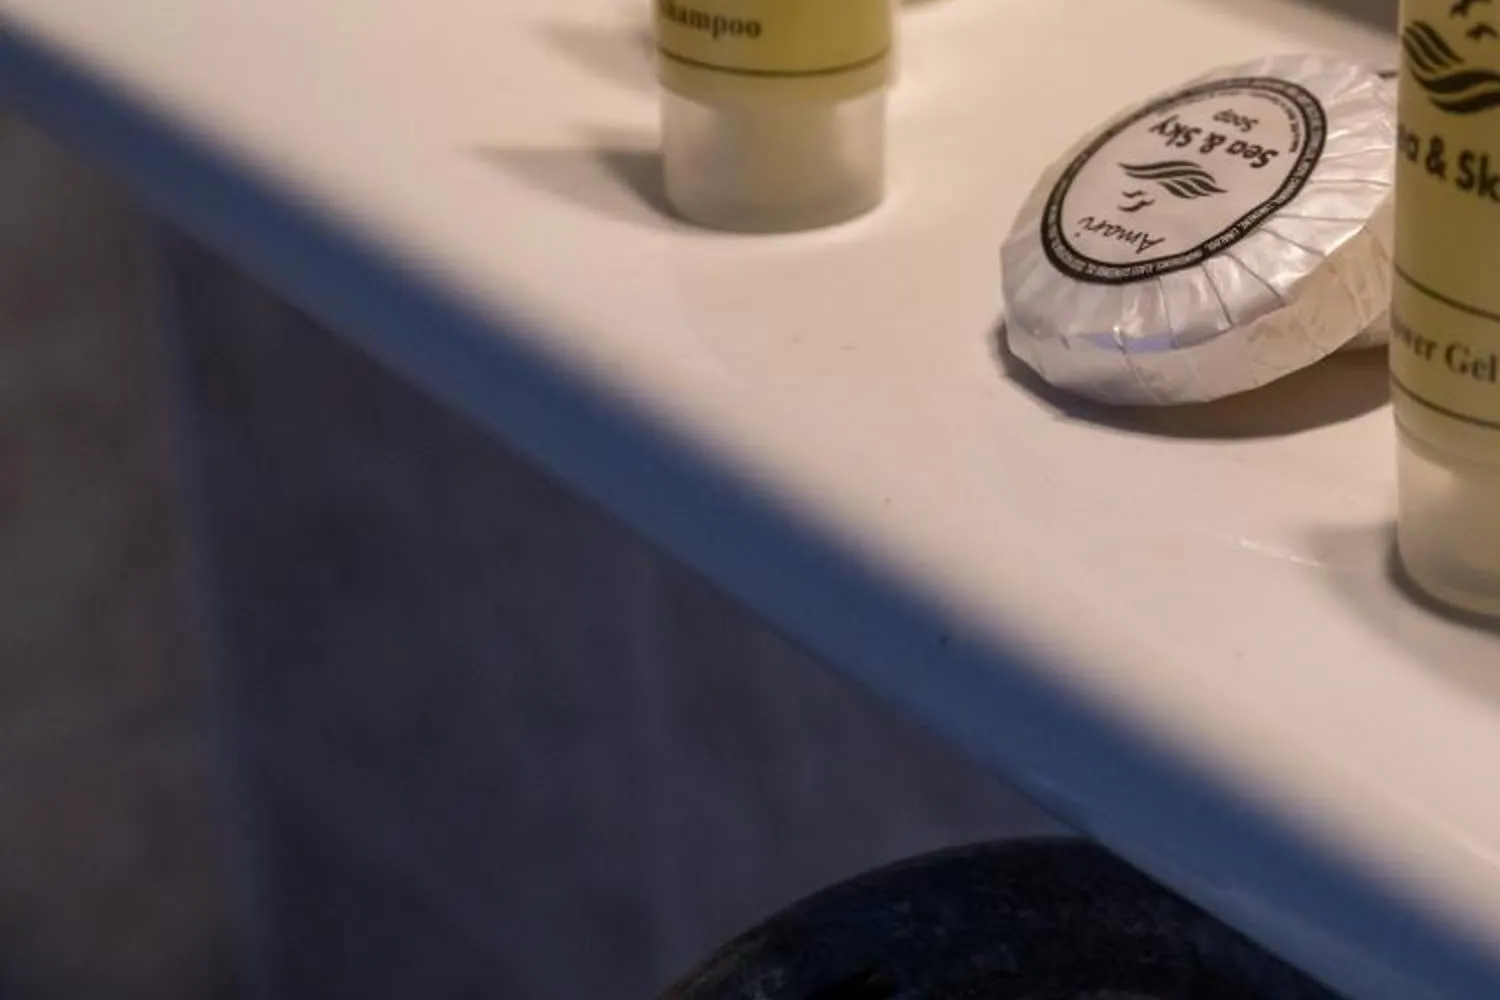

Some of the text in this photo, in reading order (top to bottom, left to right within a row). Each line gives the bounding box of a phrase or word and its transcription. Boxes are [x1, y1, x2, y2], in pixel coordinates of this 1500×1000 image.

[1147, 114, 1280, 169] Sea & Sky
[1212, 108, 1260, 133] Soap
[1424, 134, 1447, 182] &
[1073, 215, 1167, 255] Amari
[1444, 341, 1498, 384] Gel
